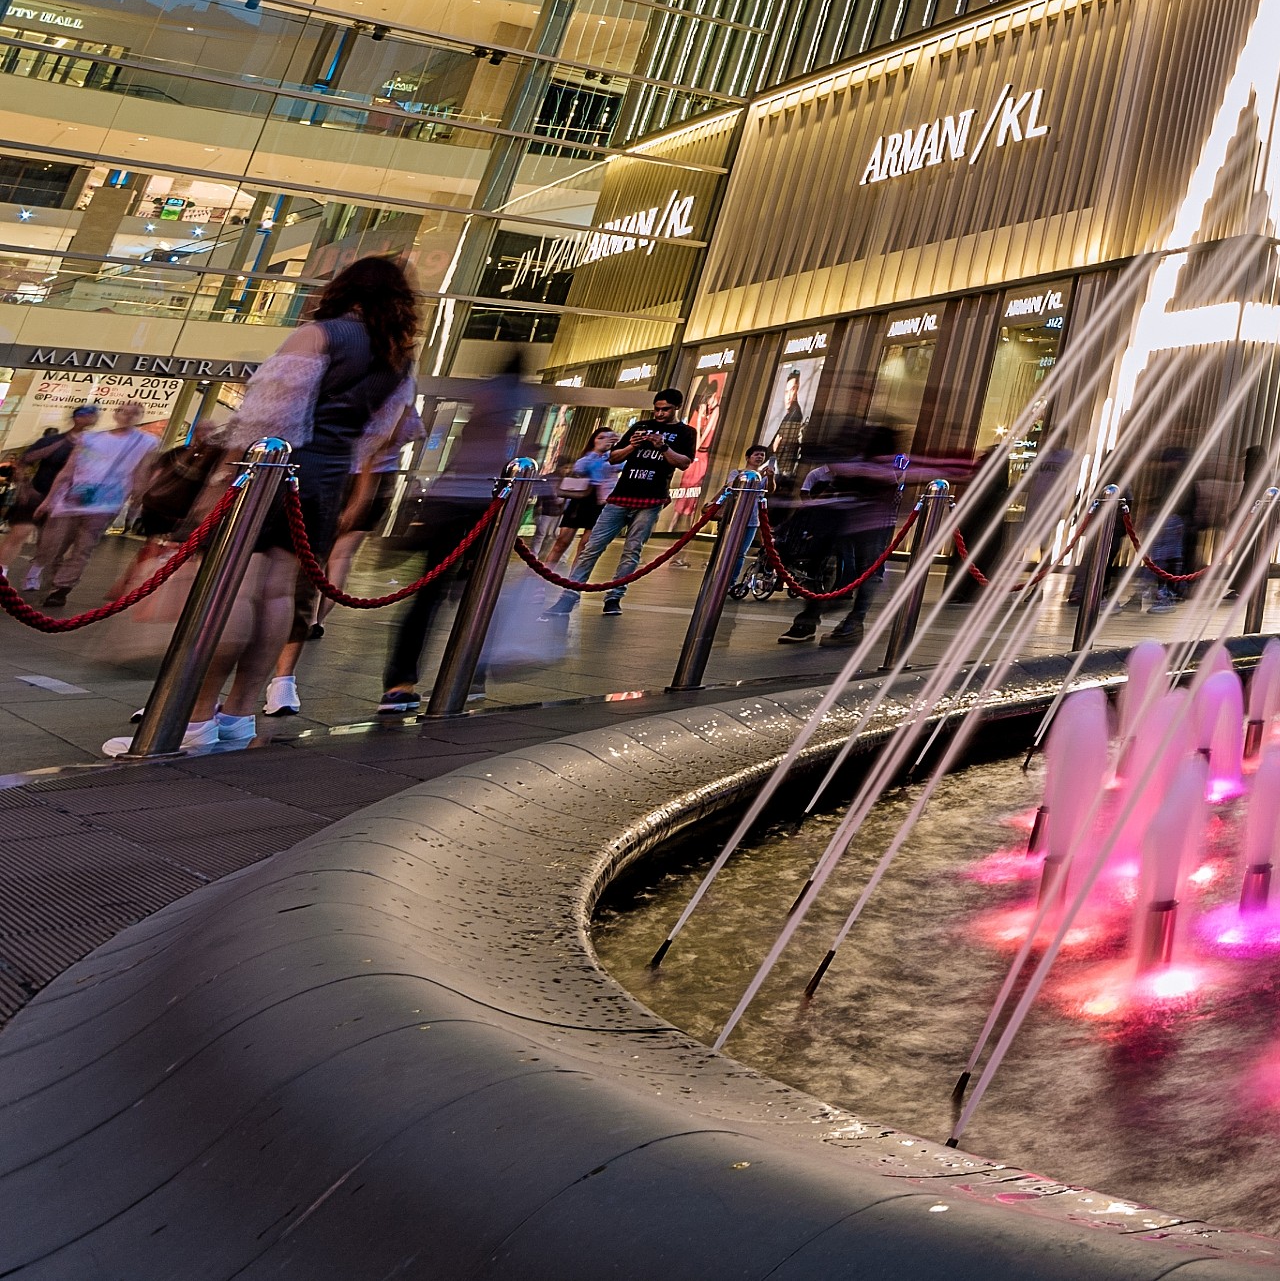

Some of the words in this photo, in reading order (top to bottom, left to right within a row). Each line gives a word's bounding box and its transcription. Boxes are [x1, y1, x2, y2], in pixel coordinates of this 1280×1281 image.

[39, 11, 84, 30] HALL
[859, 108, 978, 186] ARMANI
[29, 347, 120, 369] MAIN
[42, 370, 134, 387] MALAYSIA
[140, 377, 180, 391] 2018
[34, 392, 88, 405] @Pavilion
[94, 396, 125, 407] Kuala
[127, 400, 170, 410] Lumpur
[127, 388, 176, 402] JULY
